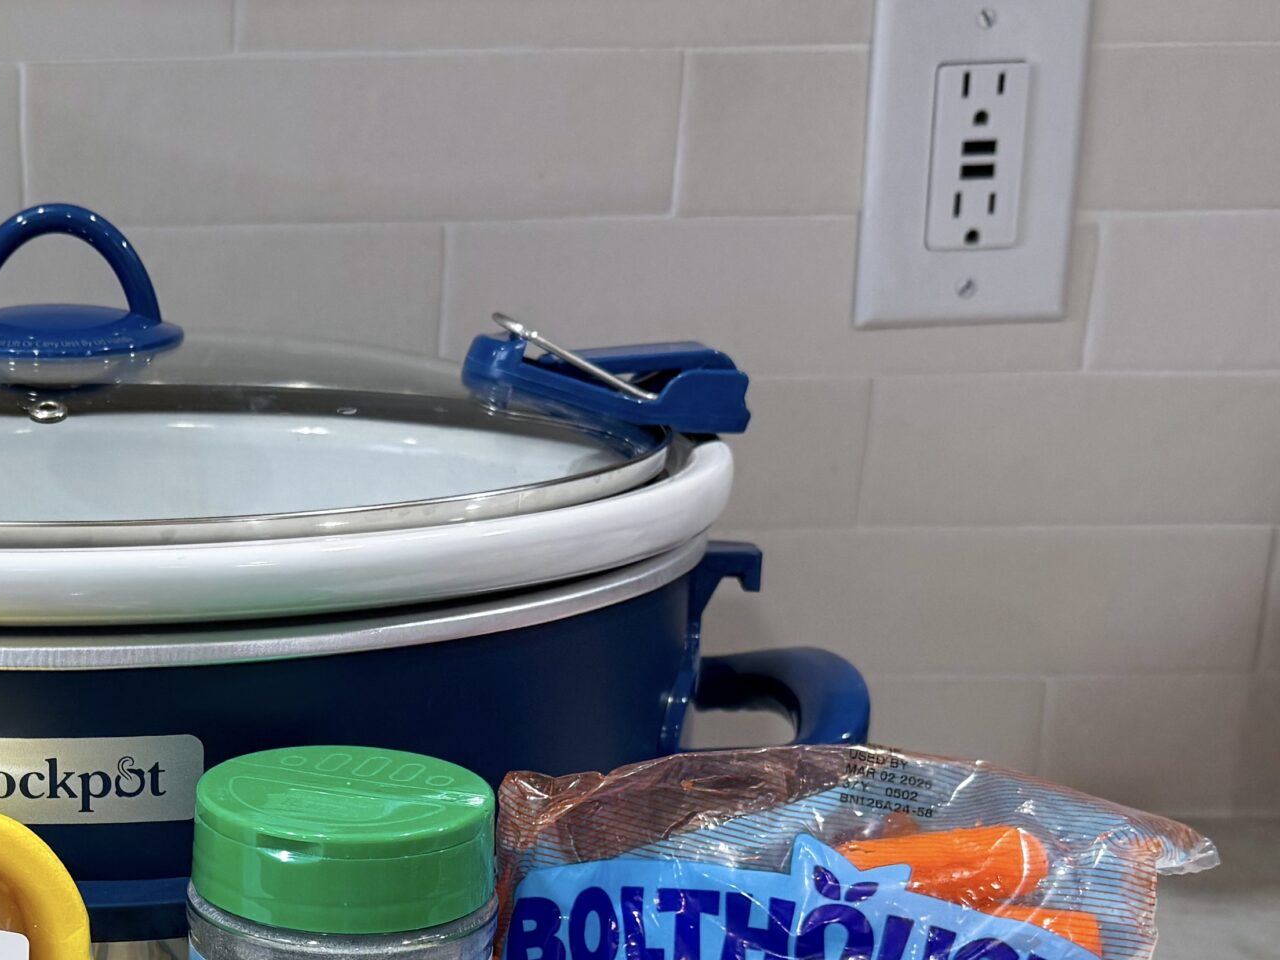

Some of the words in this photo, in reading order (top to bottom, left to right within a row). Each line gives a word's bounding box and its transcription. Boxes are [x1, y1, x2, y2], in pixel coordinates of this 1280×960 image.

[849, 749, 886, 765] USED
[890, 757, 908, 770] BY
[846, 763, 876, 778] MAR
[880, 771, 896, 783] 02
[885, 787, 918, 801] 0502
